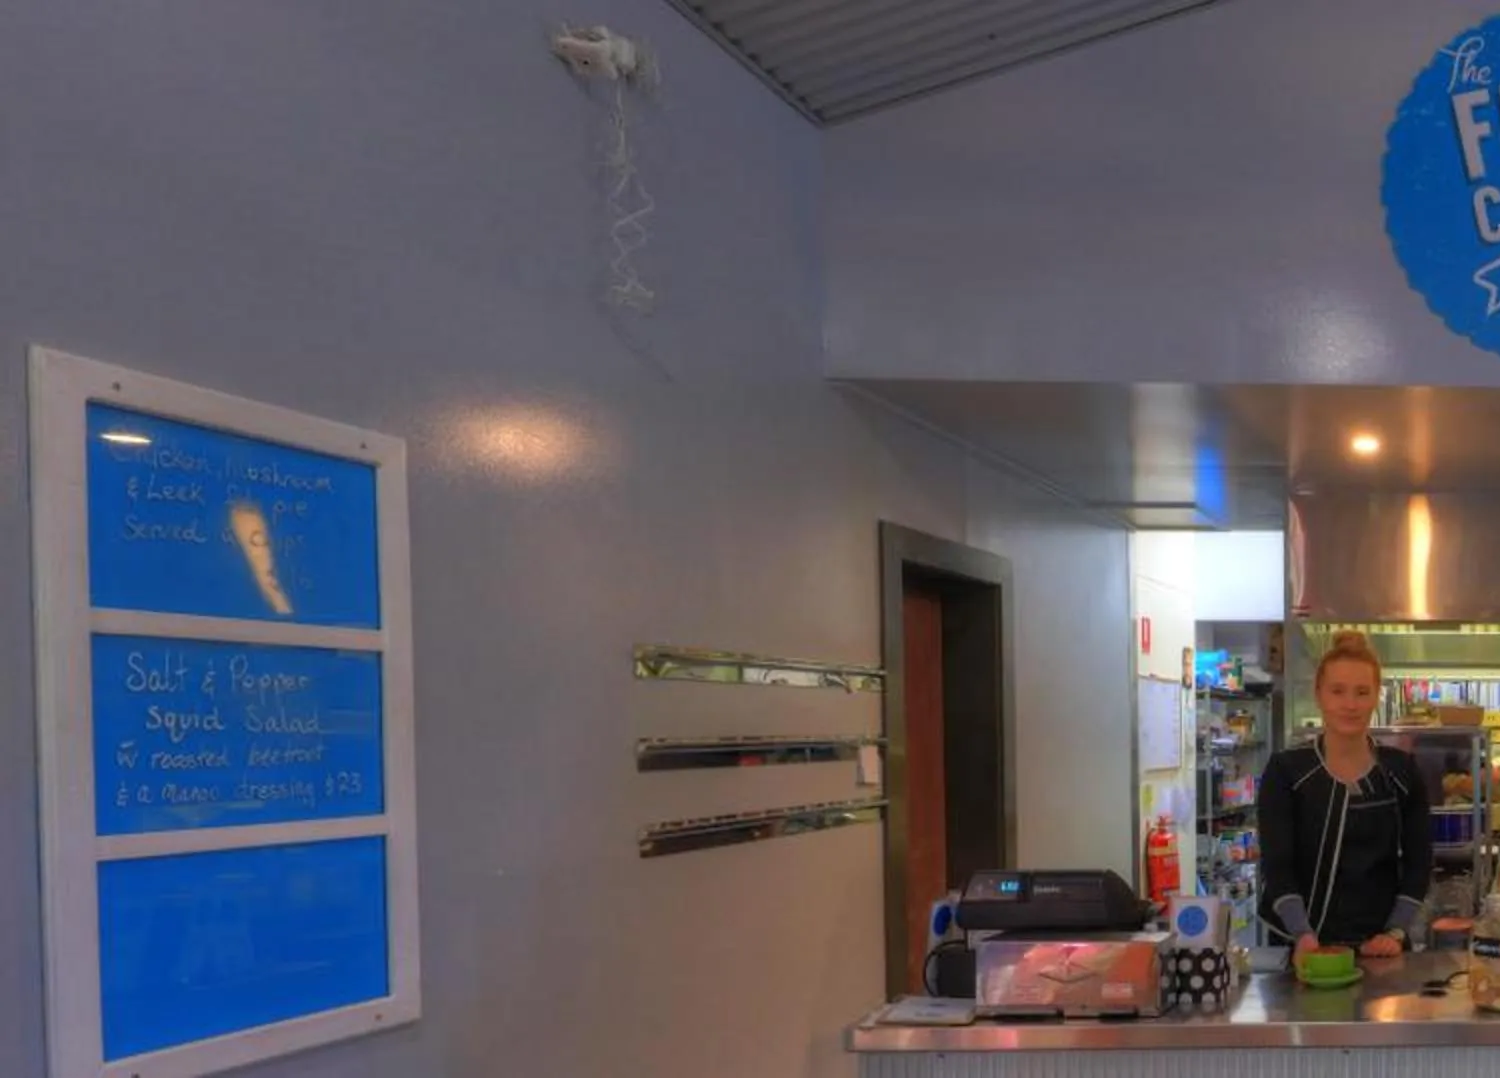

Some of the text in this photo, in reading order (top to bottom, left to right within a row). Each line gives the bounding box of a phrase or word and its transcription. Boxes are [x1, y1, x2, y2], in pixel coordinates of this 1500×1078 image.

[1439, 36, 1492, 93] The
[146, 474, 205, 506] Leek
[123, 512, 208, 545] Served
[126, 649, 188, 693] Salt
[229, 654, 310, 706] Pepper
[145, 705, 321, 743] Squid Salad
[151, 748, 230, 771] roasted
